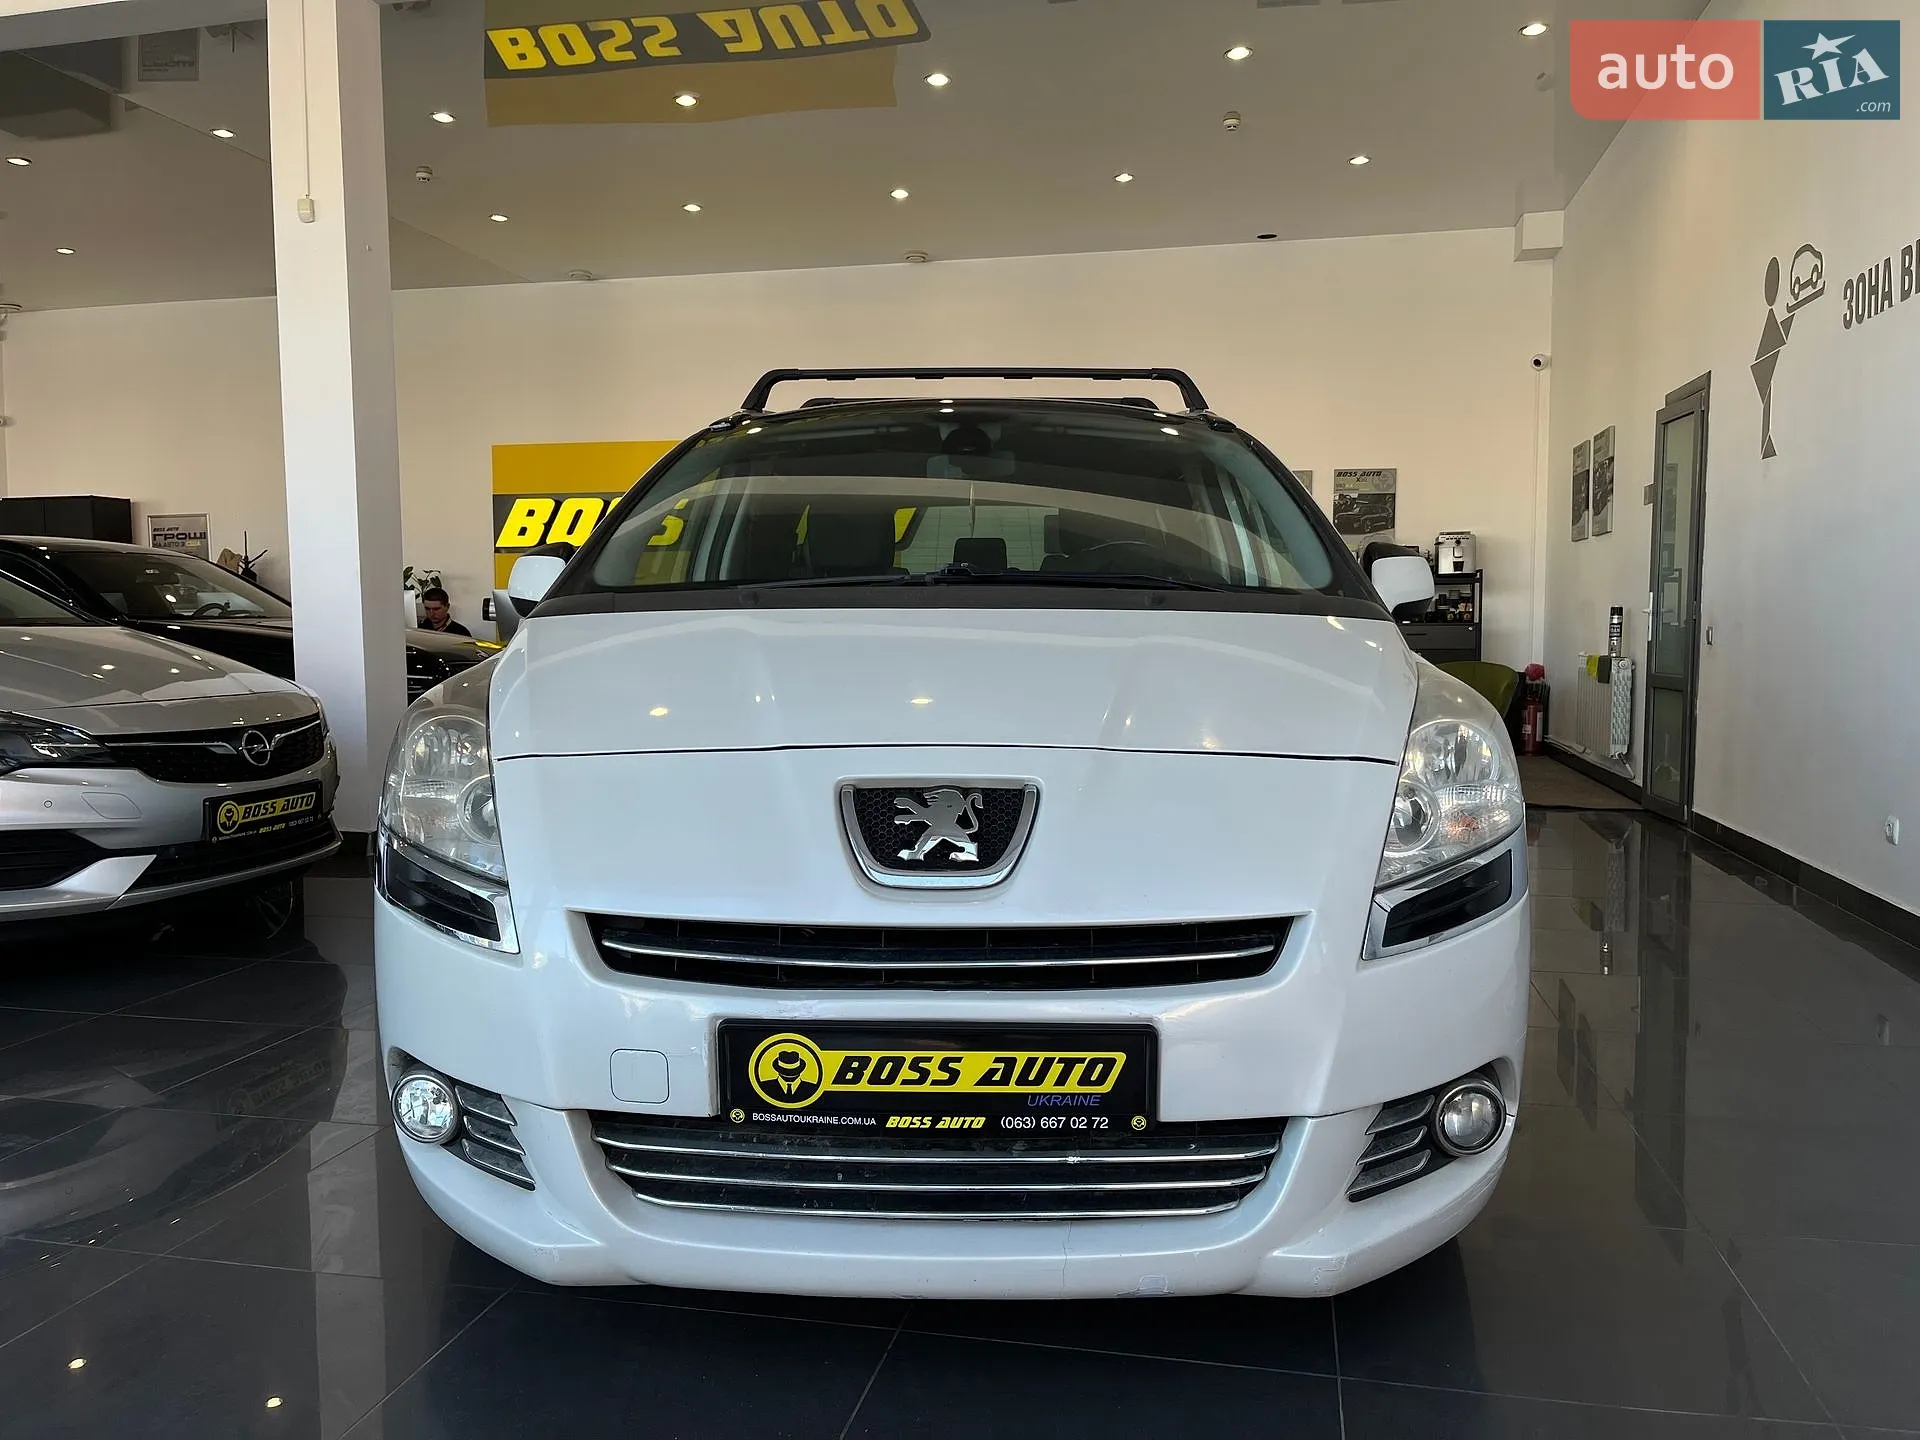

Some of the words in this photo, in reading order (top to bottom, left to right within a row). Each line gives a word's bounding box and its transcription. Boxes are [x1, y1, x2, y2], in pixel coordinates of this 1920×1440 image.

[1842, 256, 1894, 330] ЗОНА
[241, 799, 277, 819] BOSS
[280, 793, 315, 813] AUTO
[831, 1055, 964, 1086] BOSS
[973, 1056, 1118, 1087] AUTO
[1027, 1095, 1101, 1107] UKRAINE
[752, 1112, 876, 1125] BOSSAUTOUKRAINE.COM.UA
[885, 1116, 932, 1128] BOSS
[935, 1116, 986, 1129] AUTO
[1000, 1116, 1036, 1129] (063)
[1040, 1116, 1065, 1129] 667
[1070, 1116, 1088, 1129] 02
[1091, 1117, 1109, 1129] 72
